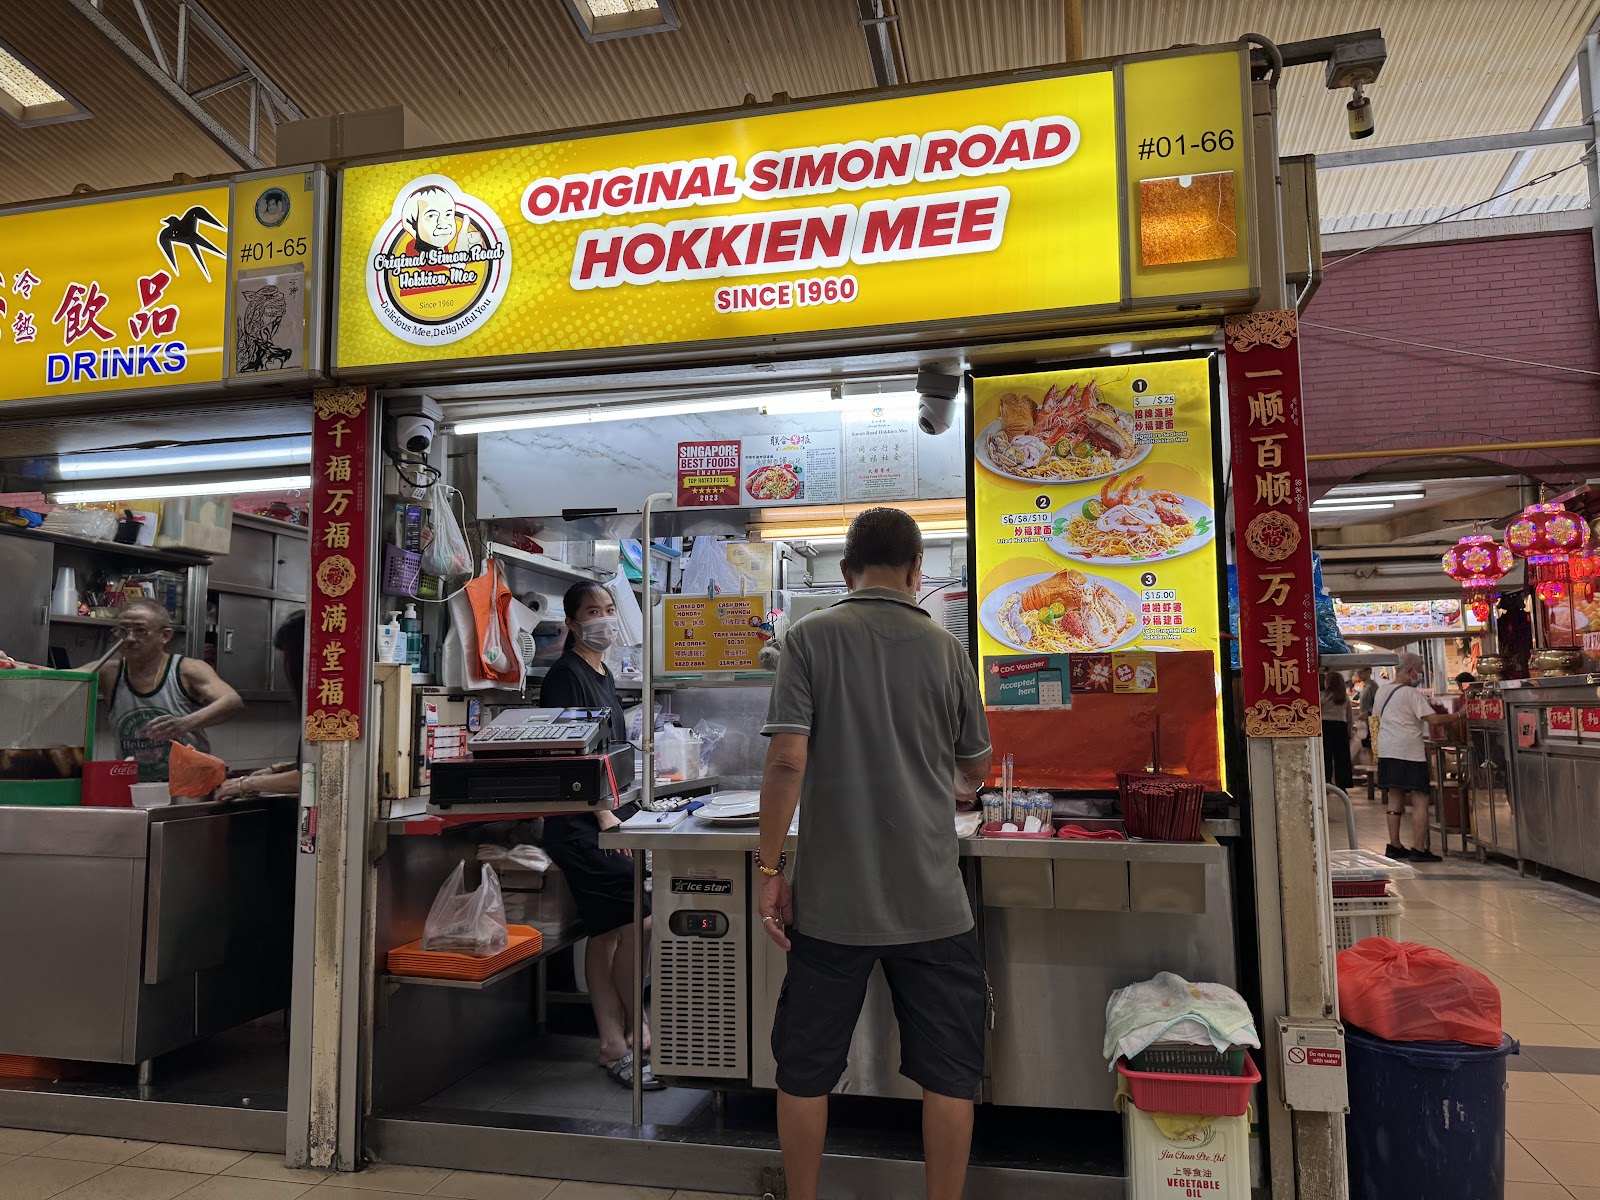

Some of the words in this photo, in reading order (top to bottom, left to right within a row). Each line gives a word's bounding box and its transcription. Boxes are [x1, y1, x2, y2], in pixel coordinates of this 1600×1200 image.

[1138, 128, 1235, 163] #01-66
[528, 163, 736, 216] ORIGINAL
[750, 144, 911, 192] SIMON
[923, 125, 1071, 174] ROAD
[580, 214, 847, 279] HOKKIEN
[861, 198, 999, 254] MEE
[240, 237, 307, 262] #01-65
[374, 251, 426, 275] Original
[428, 248, 470, 267] Simon
[469, 242, 504, 262] Road
[399, 269, 449, 289] Hokkien
[450, 266, 477, 285] Mee
[716, 286, 792, 310] SINCE
[797, 279, 855, 305] 1960
[419, 301, 437, 309] Since
[438, 299, 454, 308] 1960
[380, 300, 412, 332] Delicious
[476, 298, 491, 315] You
[48, 342, 187, 383] DRINKS
[1134, 419, 1174, 431] 炒福建面
[680, 445, 738, 458] SINGAPORE
[681, 458, 704, 469] BEST
[706, 457, 736, 468] FOODS
[699, 494, 718, 502] 2023
[1003, 514, 1048, 524] $6/$8/$10
[1014, 525, 1052, 537] 炒福建面
[1145, 591, 1174, 600] $15.00
[1142, 614, 1183, 626] 炒福建面
[1000, 666, 1015, 674] CDC
[1016, 660, 1045, 671] Voucher
[1117, 665, 1131, 676] $1
[999, 677, 1036, 691] Accepted
[1018, 687, 1036, 696] here
[703, 883, 728, 892] star
[702, 919, 707, 928] 5
[1158, 1149, 1174, 1160] Jin
[1174, 1149, 1195, 1160] Chun
[1196, 1152, 1209, 1161] Pte
[1210, 1153, 1226, 1163] Ltd
[1172, 1166, 1212, 1178] 上等食油
[1166, 1178, 1220, 1190] VEGETABLE
[1186, 1188, 1202, 1198] OIL
